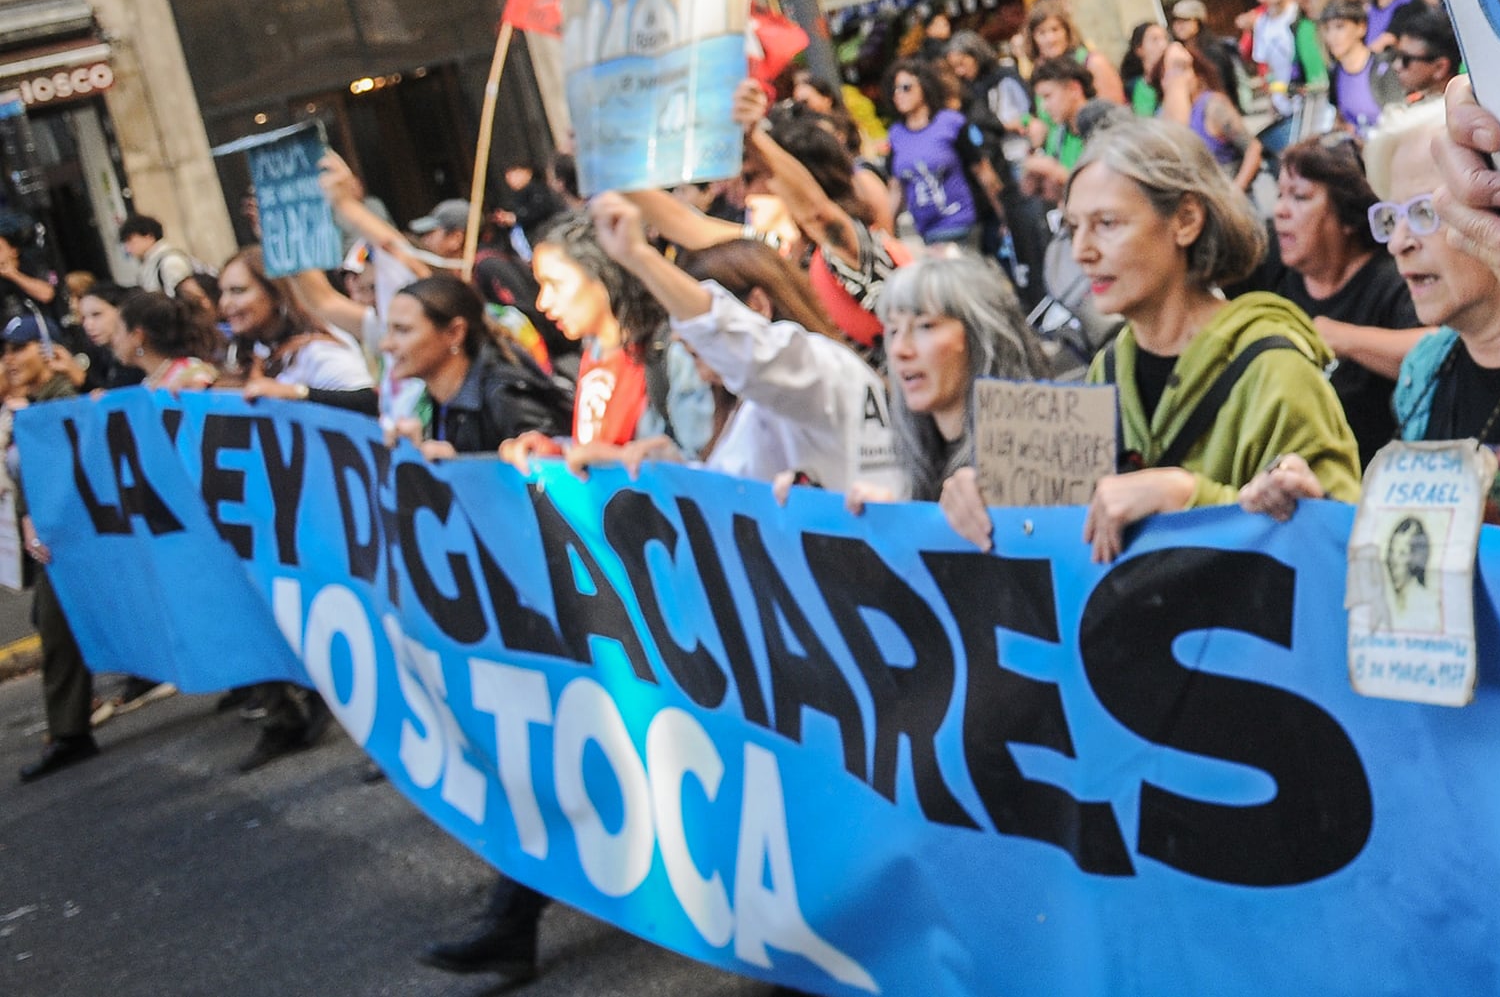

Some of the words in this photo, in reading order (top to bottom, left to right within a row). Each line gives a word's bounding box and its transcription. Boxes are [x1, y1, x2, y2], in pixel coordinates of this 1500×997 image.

[20, 62, 114, 105] IOSCO
[1384, 483, 1462, 505] ISRAEL
[62, 409, 187, 537] LA
[162, 409, 307, 566] EY
[396, 460, 1375, 889] GLACIARES
[467, 655, 881, 995] TOCA
